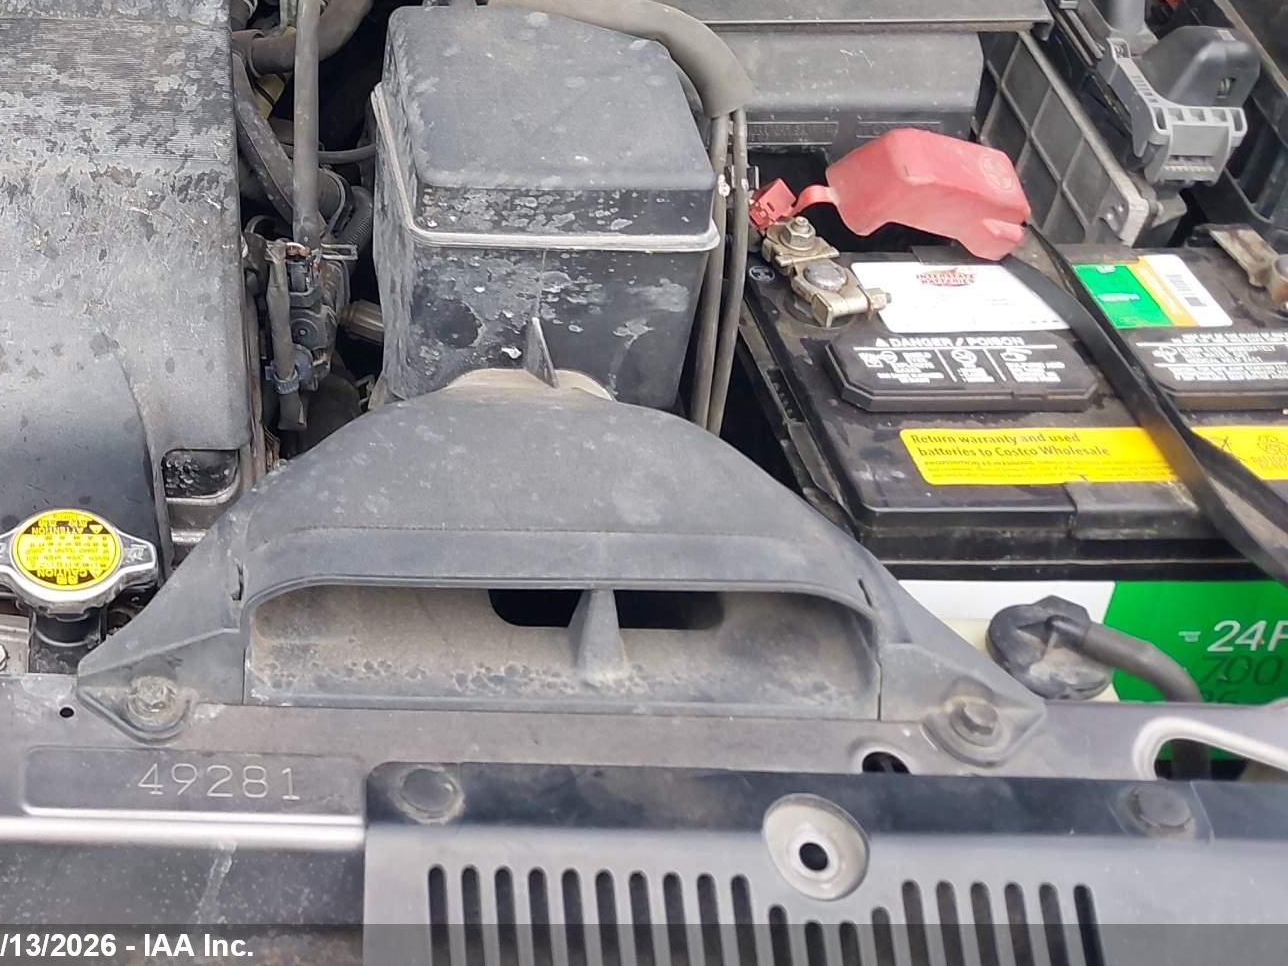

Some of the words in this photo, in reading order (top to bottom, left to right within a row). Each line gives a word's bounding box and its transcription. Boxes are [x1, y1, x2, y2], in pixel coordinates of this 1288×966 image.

[889, 338, 952, 347] DANGER
[967, 336, 1026, 346] POISON
[911, 434, 957, 444] Return
[959, 435, 1017, 446] warranty
[1022, 433, 1046, 443] and
[1049, 433, 1081, 443] used
[919, 447, 977, 457] batteries
[980, 447, 993, 457] to
[995, 446, 1039, 457] Costco
[1040, 445, 1111, 456] Wholesale
[31, 526, 85, 535] ATTENTION
[37, 569, 89, 578] CAUTION
[1202, 654, 1285, 686] 700
[137, 762, 301, 801] 49281
